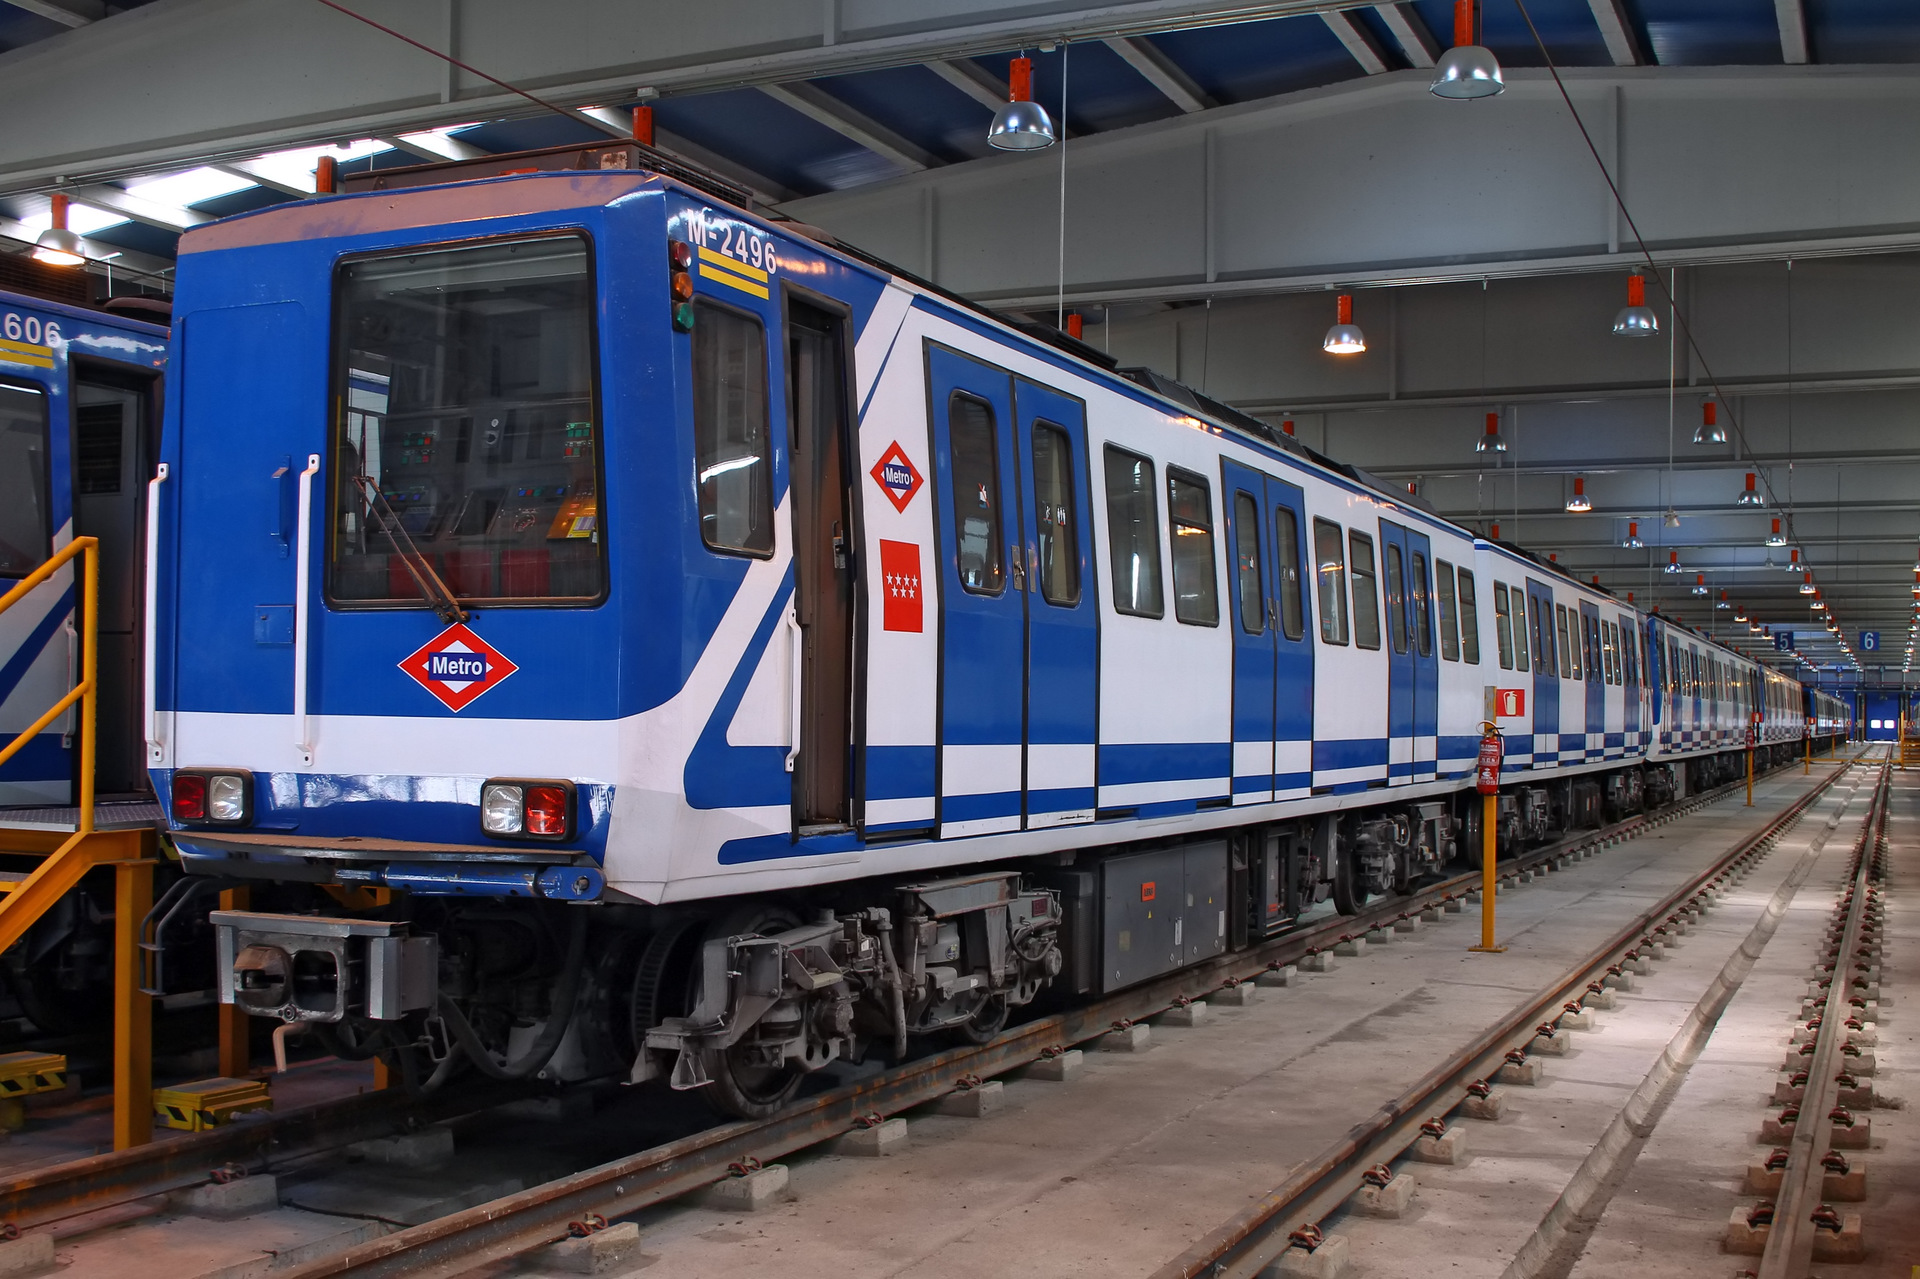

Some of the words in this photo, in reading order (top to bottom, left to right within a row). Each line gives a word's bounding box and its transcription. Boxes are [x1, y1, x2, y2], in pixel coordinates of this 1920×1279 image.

[687, 208, 777, 275] M-2496
[0, 312, 61, 348] 606
[885, 466, 910, 485] Metro
[1780, 632, 1789, 650] 5
[1864, 632, 1874, 650] 6
[432, 656, 483, 676] Metro
